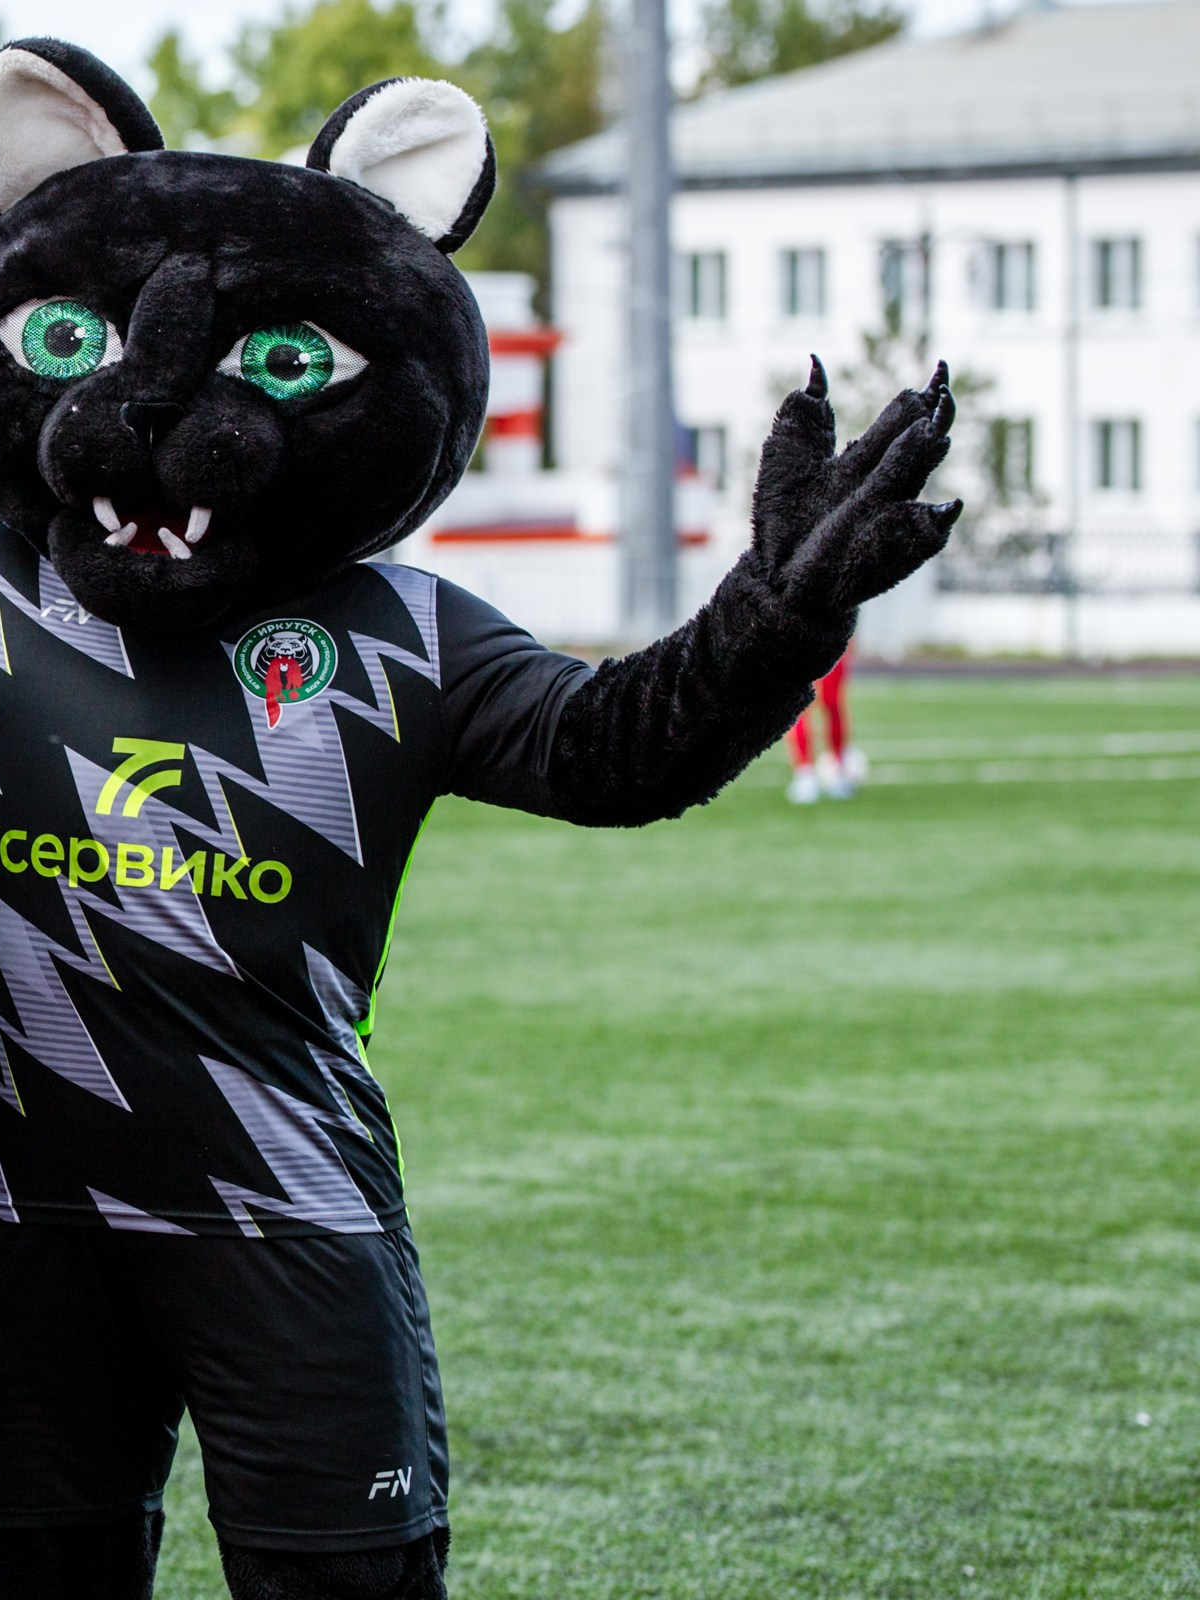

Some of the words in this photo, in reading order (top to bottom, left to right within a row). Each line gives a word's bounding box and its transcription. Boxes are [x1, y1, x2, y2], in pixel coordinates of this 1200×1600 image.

[257, 621, 319, 638] ИРКУТСК
[0, 828, 293, 905] сервико
[367, 1465, 413, 1500] FN
